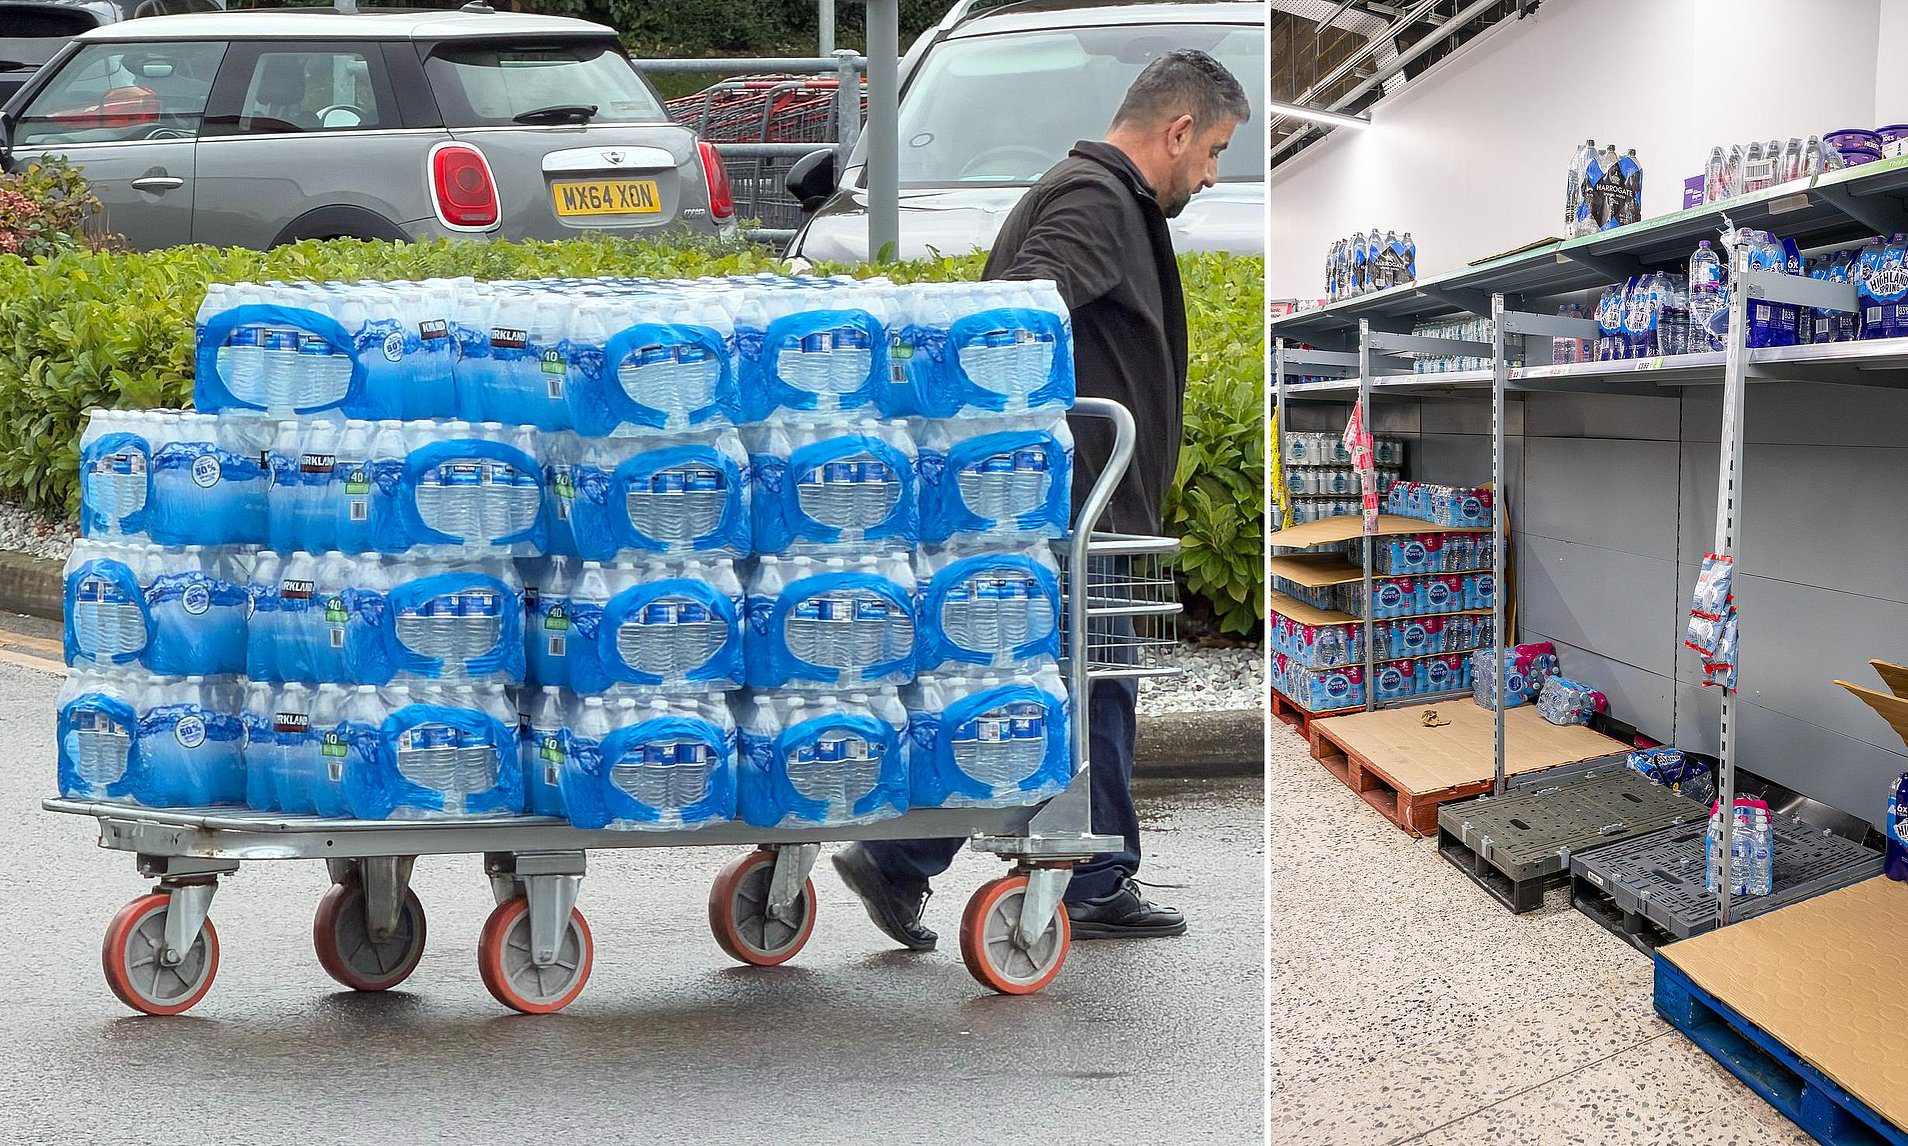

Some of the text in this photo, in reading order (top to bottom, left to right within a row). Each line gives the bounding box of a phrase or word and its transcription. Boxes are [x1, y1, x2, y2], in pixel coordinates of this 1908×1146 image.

[562, 183, 655, 211] MX64 XON
[1596, 183, 1633, 198] HARROGATE
[1870, 271, 1908, 292] HIGHLAND
[350, 472, 363, 483] 40
